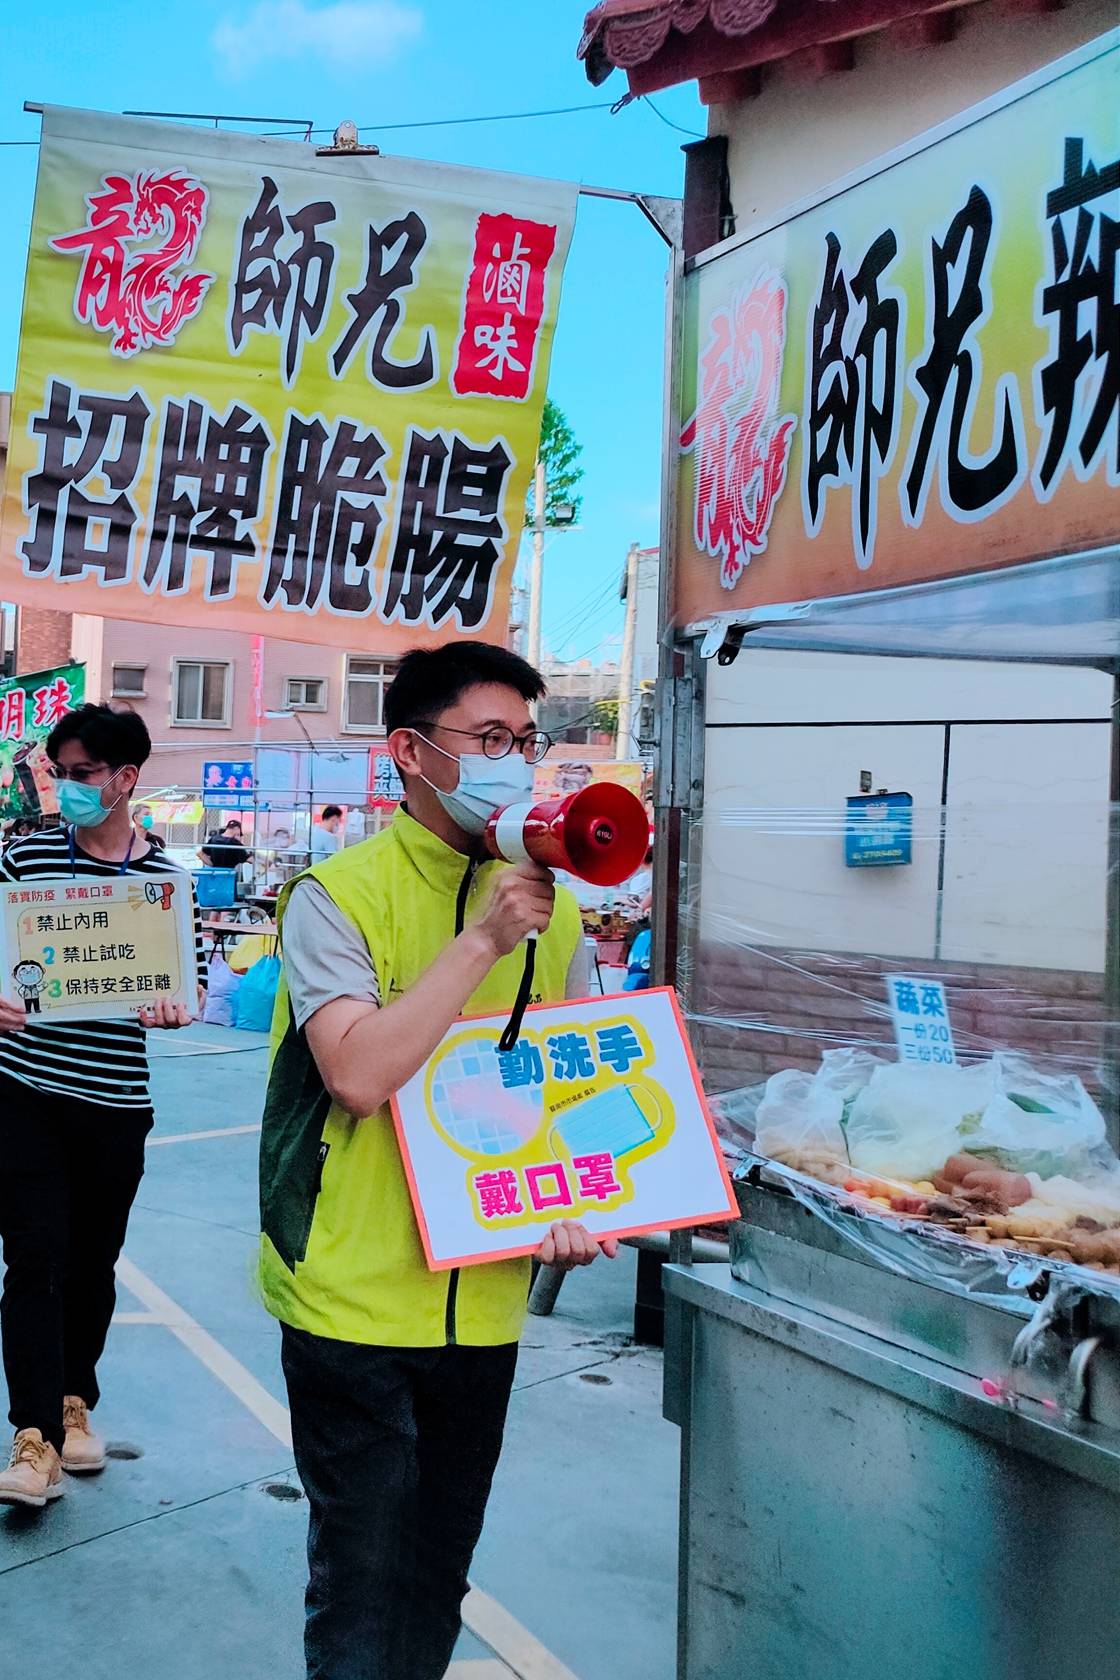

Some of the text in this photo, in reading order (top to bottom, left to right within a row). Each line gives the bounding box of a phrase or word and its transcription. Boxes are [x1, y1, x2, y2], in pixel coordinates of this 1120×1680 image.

[230, 175, 436, 388] 師兄
[471, 232, 532, 382] 滷味
[20, 378, 512, 630] 招牌脆腸
[7, 885, 114, 904] 落實防疫 緊戴口罩
[36, 911, 109, 932] 禁止內用
[42, 943, 136, 965] 2 禁止試吃
[47, 973, 172, 998] 3 保持安全距離
[494, 1024, 643, 1089] 勤洗手
[474, 1152, 621, 1218] 戴口罩
